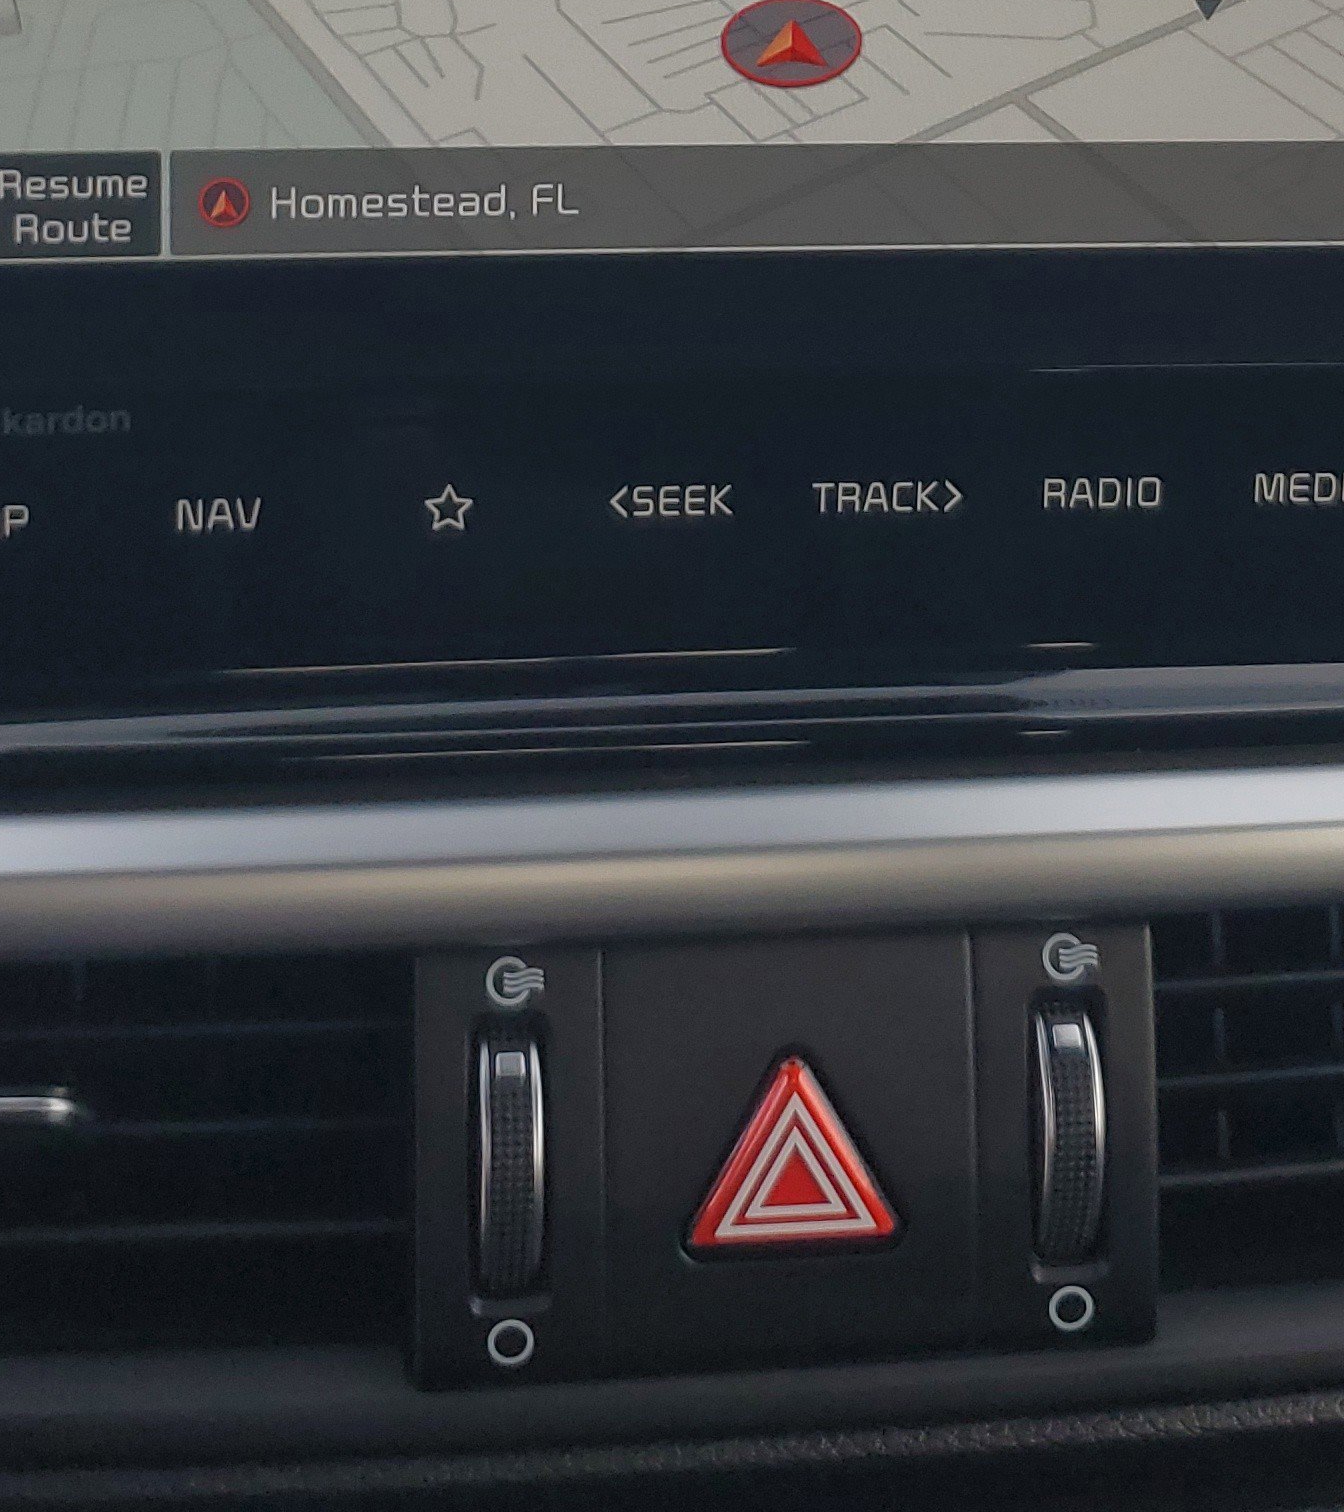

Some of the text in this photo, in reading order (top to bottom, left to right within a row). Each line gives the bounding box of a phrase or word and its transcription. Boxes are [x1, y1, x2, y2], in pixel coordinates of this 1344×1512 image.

[271, 184, 579, 220] Homestead, FL
[14, 213, 132, 244] Route
[2, 405, 131, 436] kardon
[1042, 476, 1162, 510] RADIO
[176, 497, 262, 532] NAV
